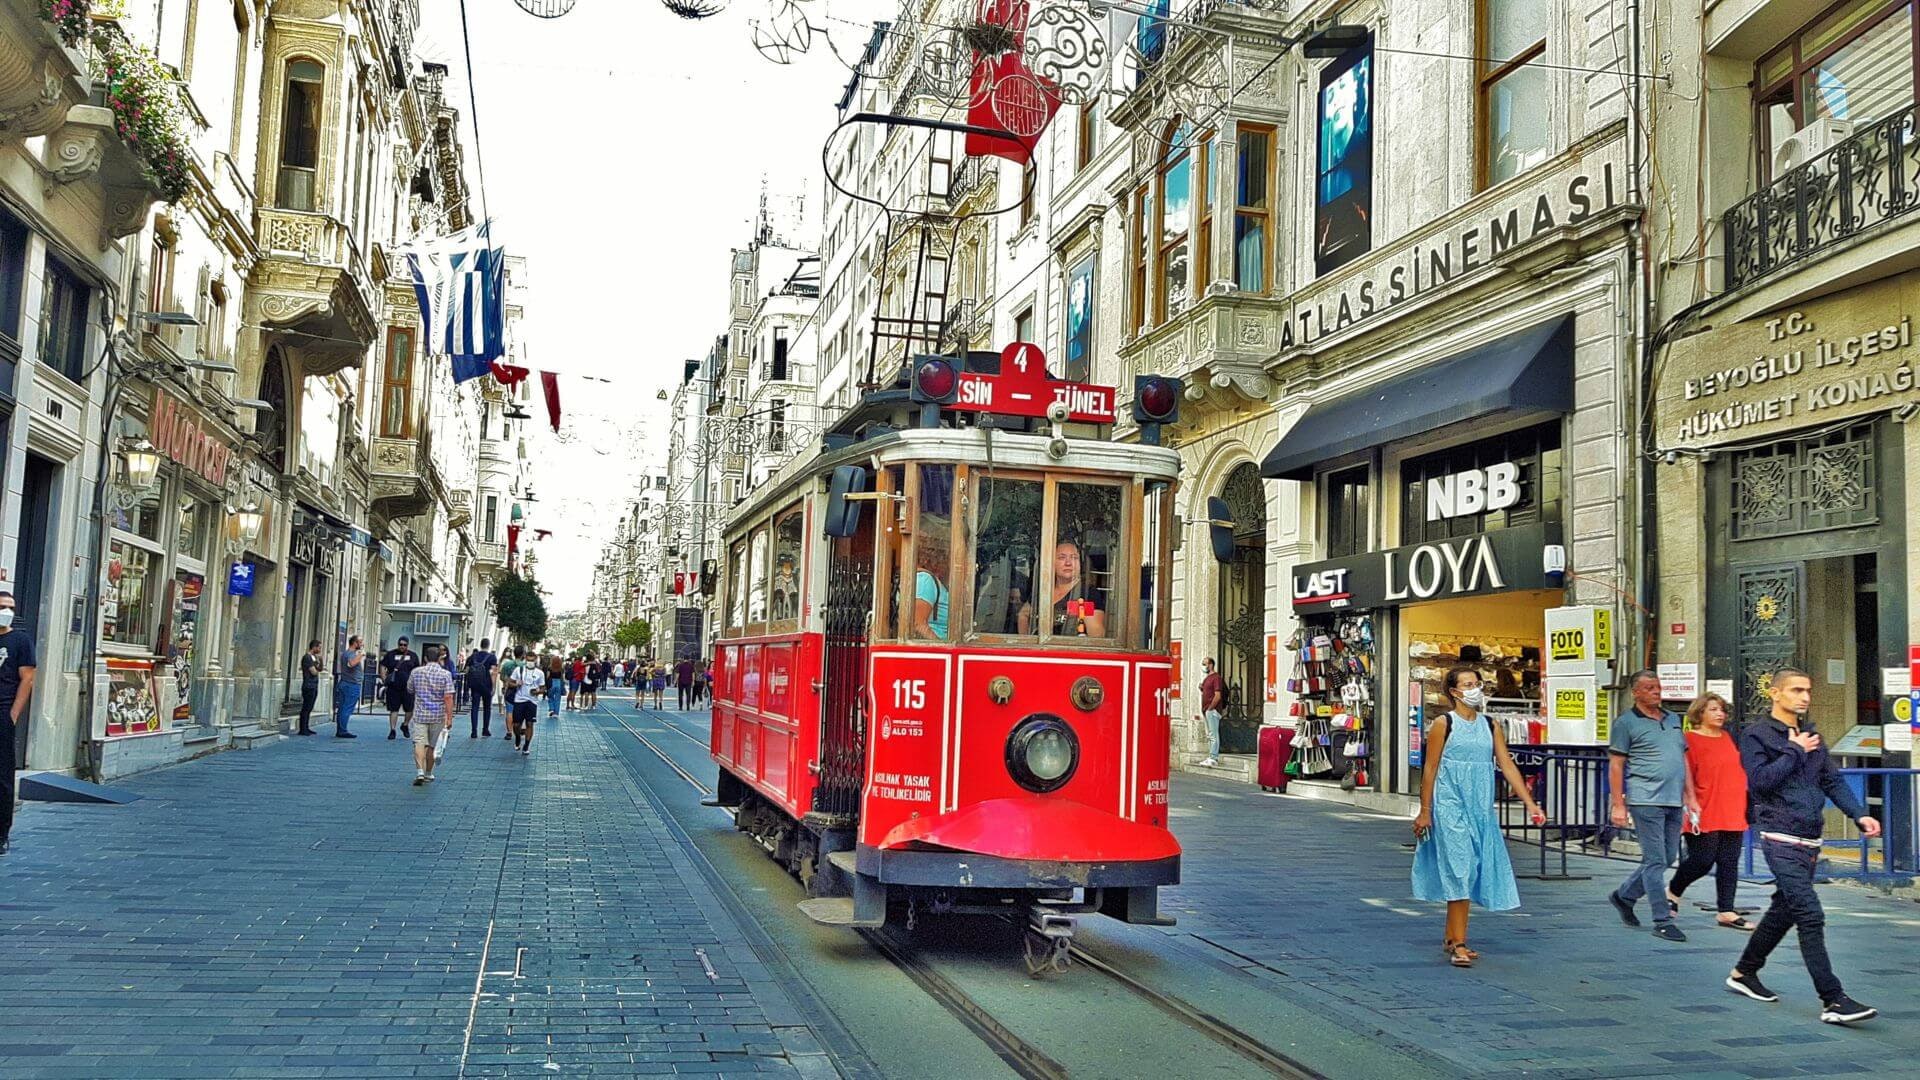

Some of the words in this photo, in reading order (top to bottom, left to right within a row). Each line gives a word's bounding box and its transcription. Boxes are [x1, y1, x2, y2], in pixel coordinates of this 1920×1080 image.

[1280, 280, 1374, 351] ATLAS
[1390, 162, 1617, 305] SİNEMASI
[1766, 312, 1814, 342] T.C.
[1014, 345, 1028, 373] 4
[1685, 350, 1804, 401] BEYOĞLU
[1815, 315, 1913, 367] İLÇESİ
[1053, 385, 1112, 416] TÜNEL
[1677, 392, 1799, 440] HÜKÜMET
[1426, 461, 1521, 522] NBB
[1293, 568, 1348, 598] LAST
[1384, 535, 1506, 601] LOYA
[1551, 631, 1583, 649] FOTO
[892, 679, 926, 709] 115
[1556, 691, 1585, 702] FOTO
[903, 774, 930, 787] YASAK
[1143, 793, 1153, 805] VE
